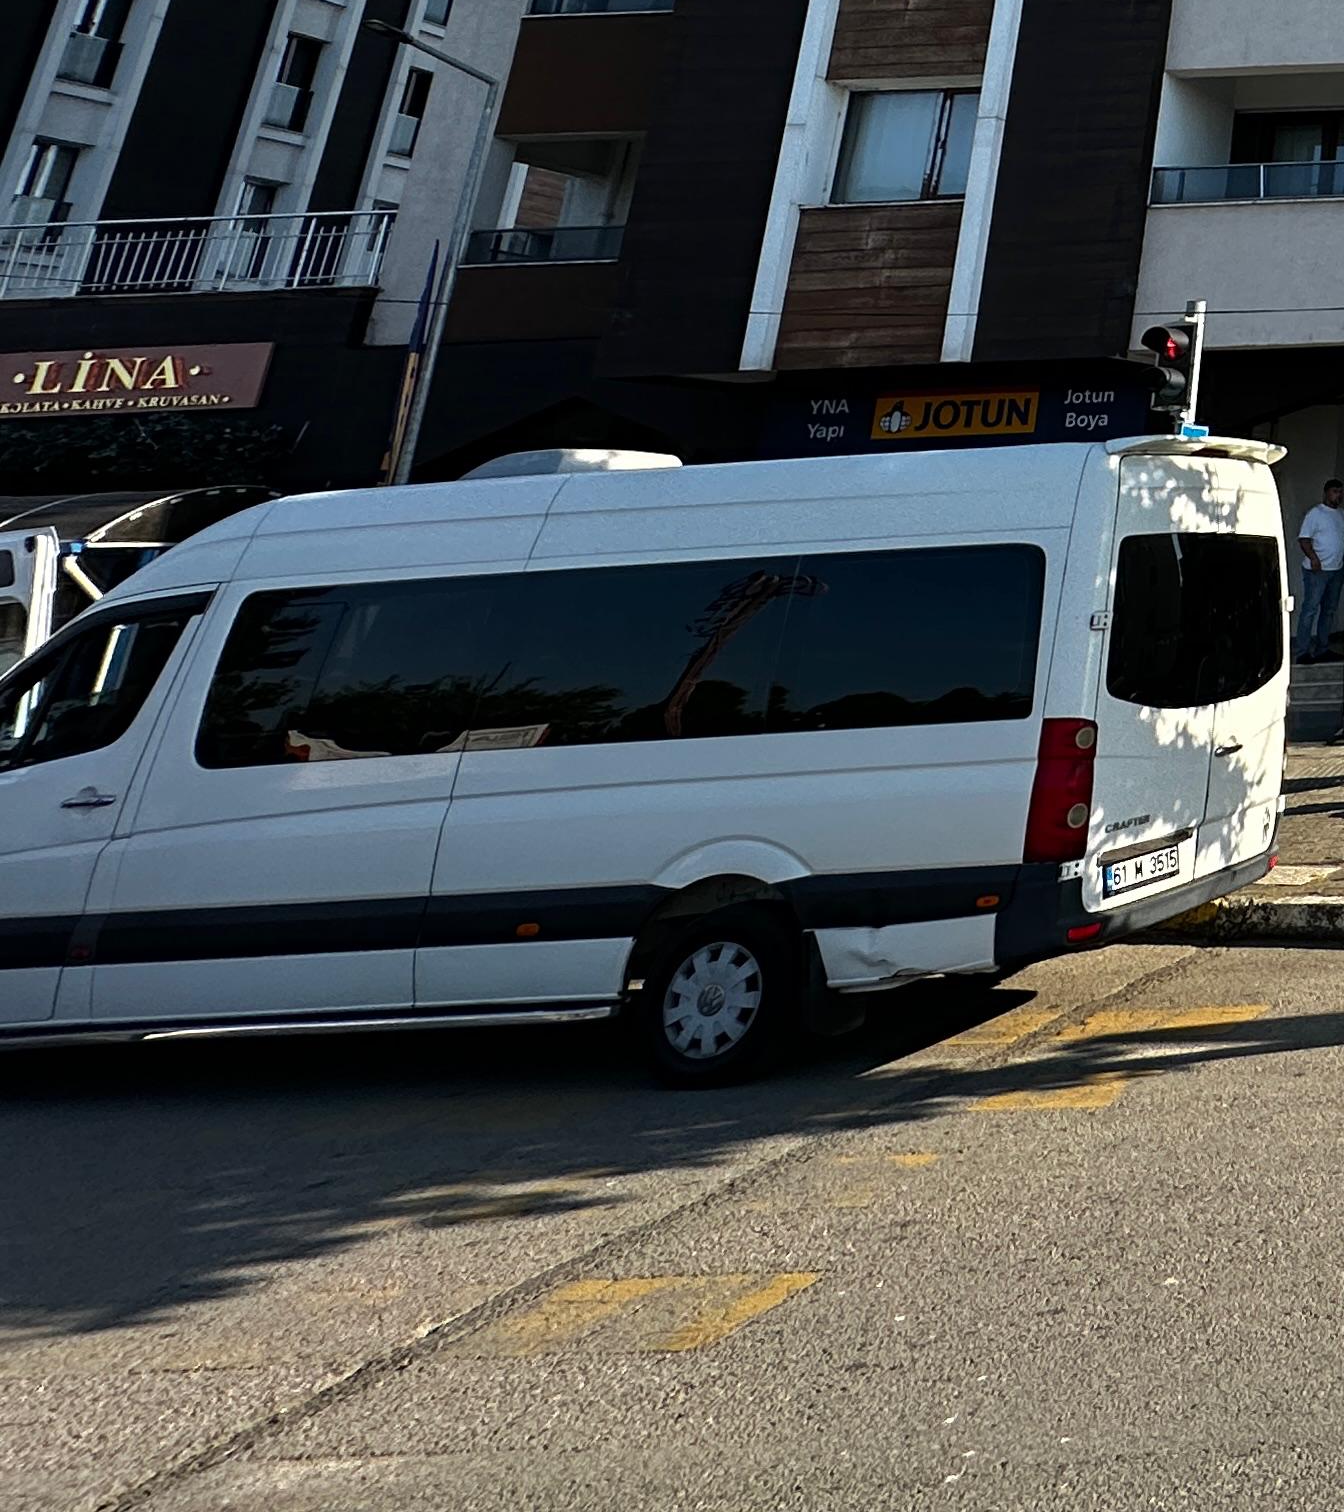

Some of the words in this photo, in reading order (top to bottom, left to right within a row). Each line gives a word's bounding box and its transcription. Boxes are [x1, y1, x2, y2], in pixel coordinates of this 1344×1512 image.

[25, 351, 180, 395] LİNA
[136, 394, 222, 409] KRUVASAN
[810, 398, 850, 415] YNA
[1063, 389, 1115, 405] Jotun
[913, 397, 1033, 432] JOTUN
[1064, 412, 1109, 431] Boya
[806, 422, 845, 442] Yapı
[1112, 864, 1128, 886] 61
[1149, 848, 1178, 876] 3515
